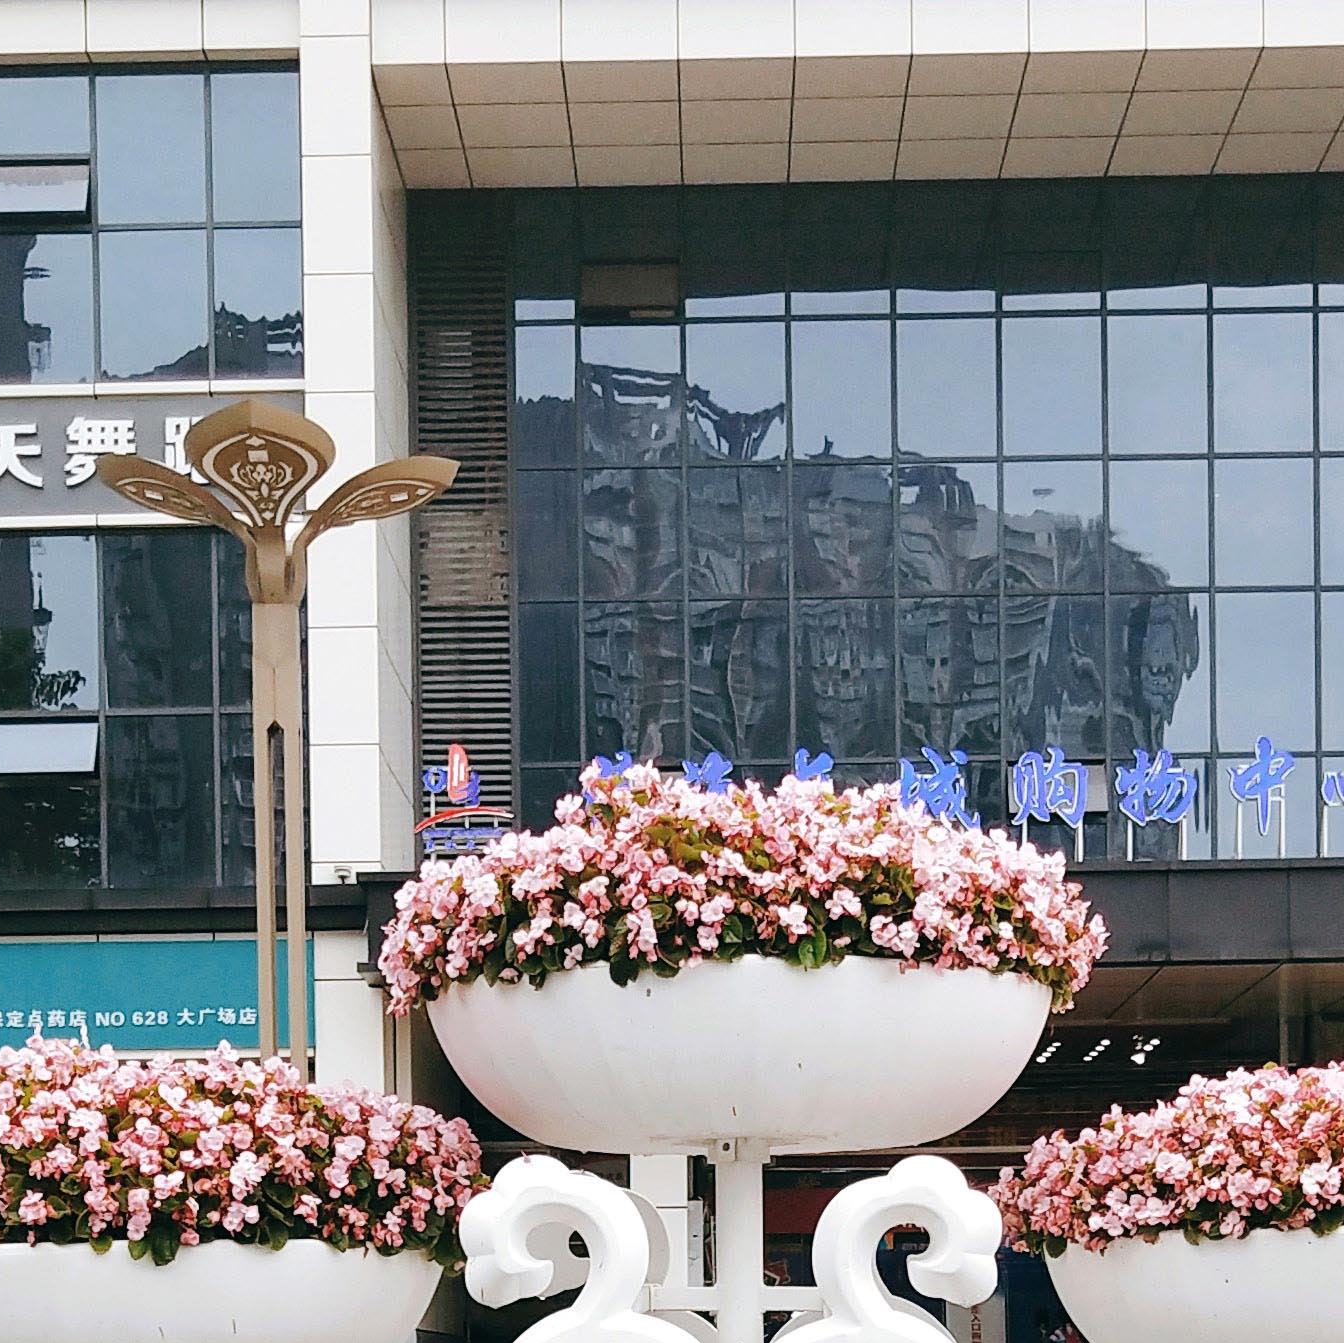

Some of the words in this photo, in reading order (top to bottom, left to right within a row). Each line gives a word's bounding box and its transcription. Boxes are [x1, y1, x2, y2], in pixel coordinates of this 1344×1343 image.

[95, 1011, 125, 1027] NO
[132, 1010, 169, 1026] 628
[176, 1007, 258, 1026] 大广场店
